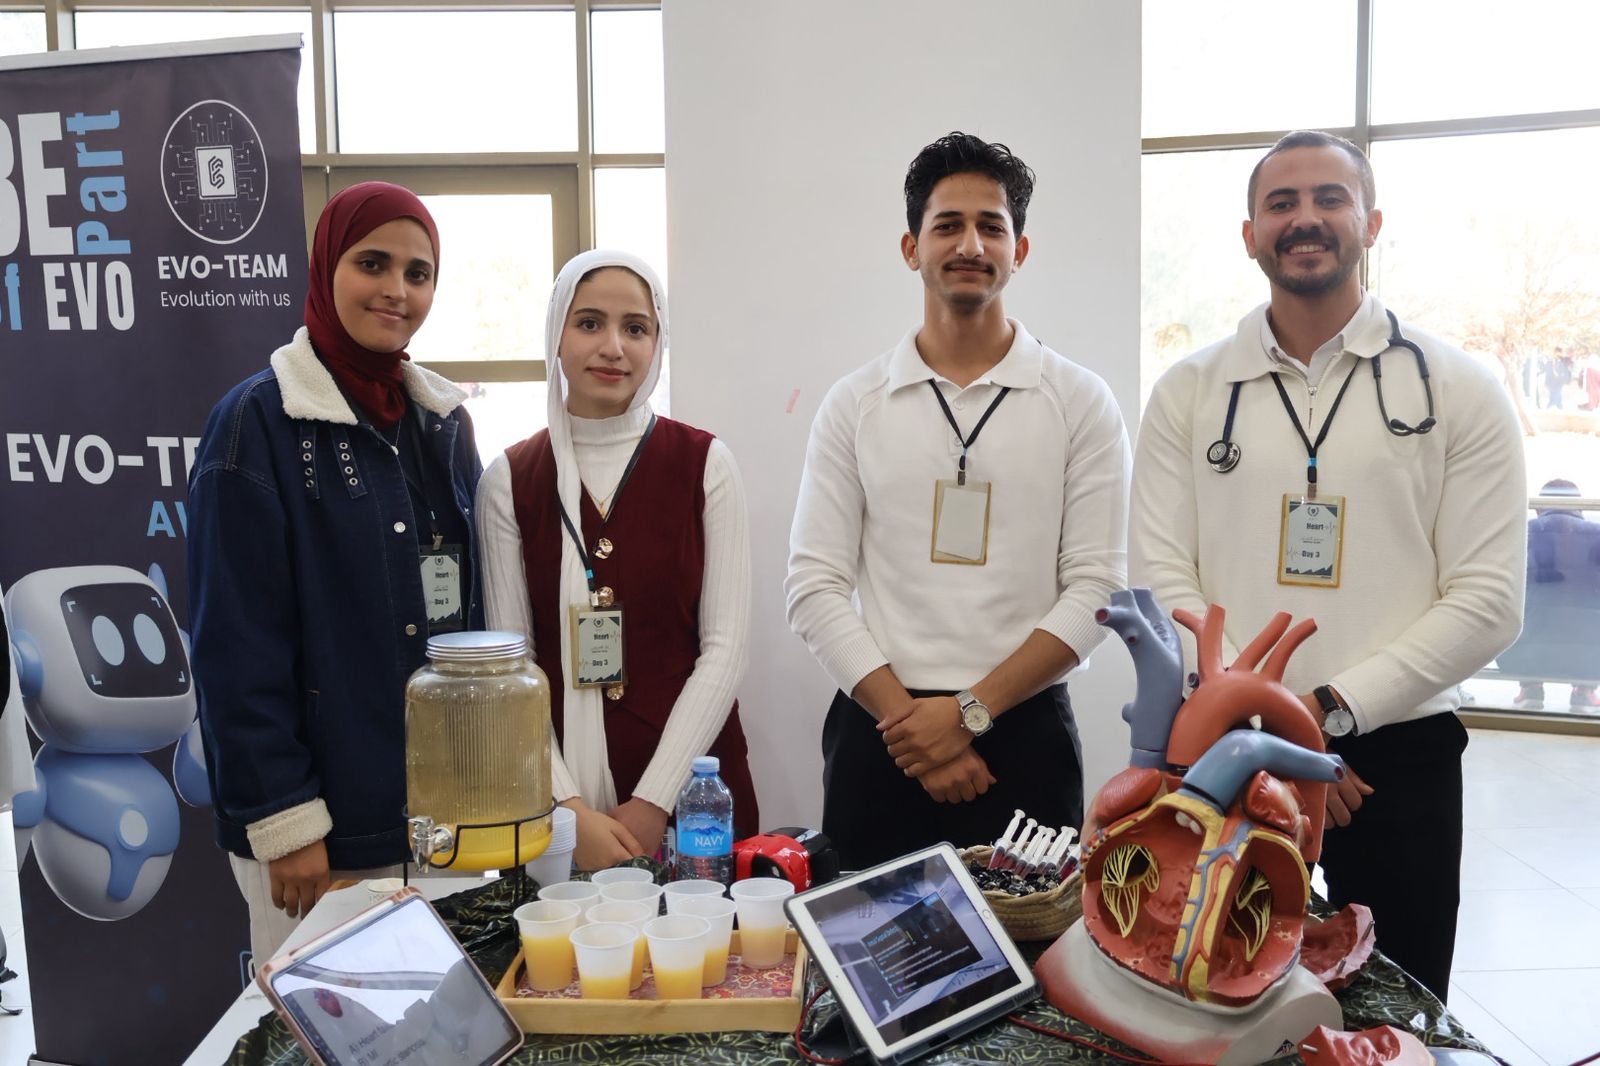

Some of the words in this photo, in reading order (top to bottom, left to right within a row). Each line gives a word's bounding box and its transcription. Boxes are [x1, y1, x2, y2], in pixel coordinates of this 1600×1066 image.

[158, 254, 288, 279] EVO-TEAM
[0, 263, 22, 330] f
[43, 261, 135, 330] EVO
[161, 290, 235, 307] Evolution
[239, 290, 269, 306] with
[273, 293, 291, 306] us
[1302, 550, 1314, 558] Day
[695, 834, 725, 847] NAVY
